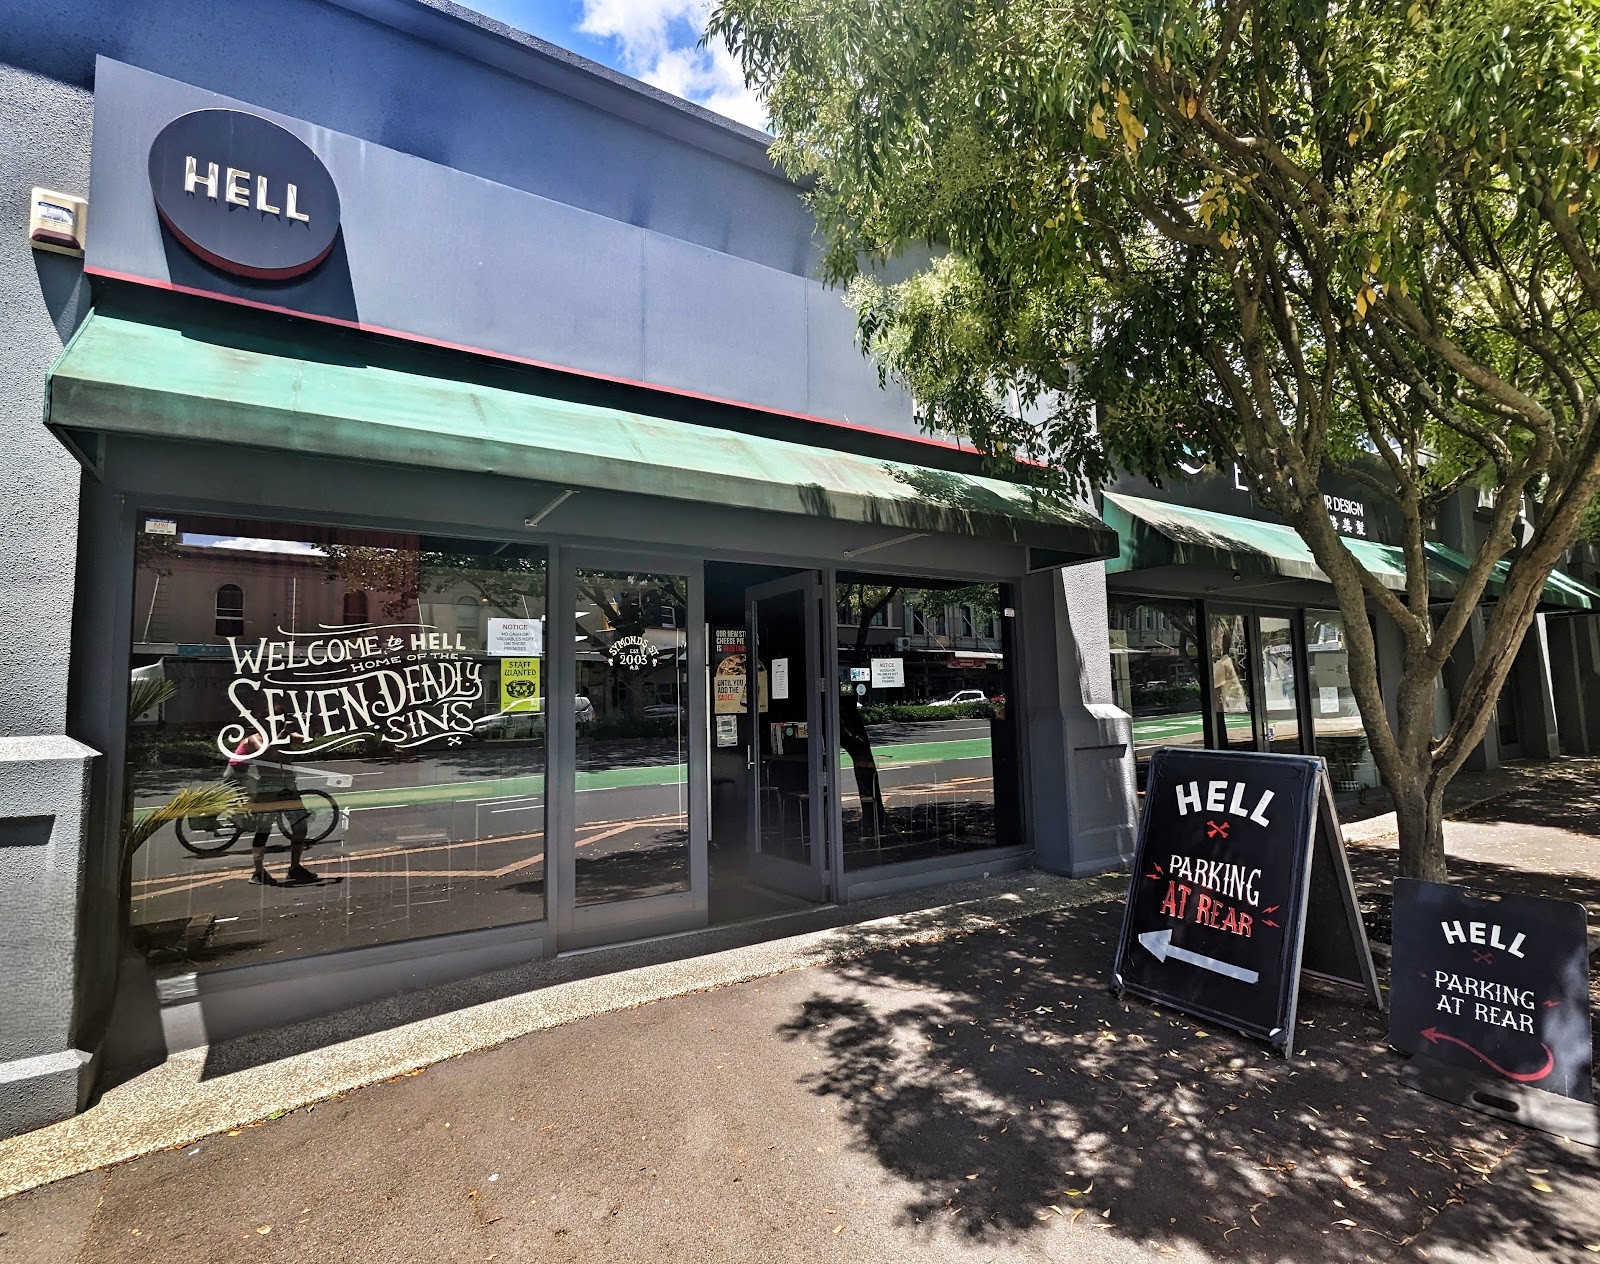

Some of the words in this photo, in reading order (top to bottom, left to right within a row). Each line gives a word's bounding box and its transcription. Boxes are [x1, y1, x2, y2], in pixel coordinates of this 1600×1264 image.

[184, 156, 310, 222] HELL
[1333, 496, 1364, 517] DESIGN
[226, 635, 382, 676] WELCOME
[386, 634, 405, 650] to
[410, 632, 467, 651] HELL
[608, 635, 649, 656] SYMONDS
[648, 645, 660, 656] ST
[619, 654, 648, 665] 2003
[716, 637, 736, 645] CHEESE
[351, 656, 402, 673] HOME
[407, 653, 428, 661] OF
[431, 652, 459, 660] THE
[504, 669, 537, 677] WANTED
[217, 678, 376, 760] SEVEN
[371, 661, 483, 717] DEADLY
[381, 701, 475, 743] SINS
[1175, 780, 1275, 828] HELL
[1169, 854, 1262, 907] PARKING
[1160, 880, 1192, 919] AT
[1195, 893, 1254, 938] REAR
[1441, 920, 1527, 959] HELL
[1434, 970, 1535, 1010] PARKING
[1436, 994, 1465, 1016] AT
[1474, 1003, 1535, 1035] REAR
